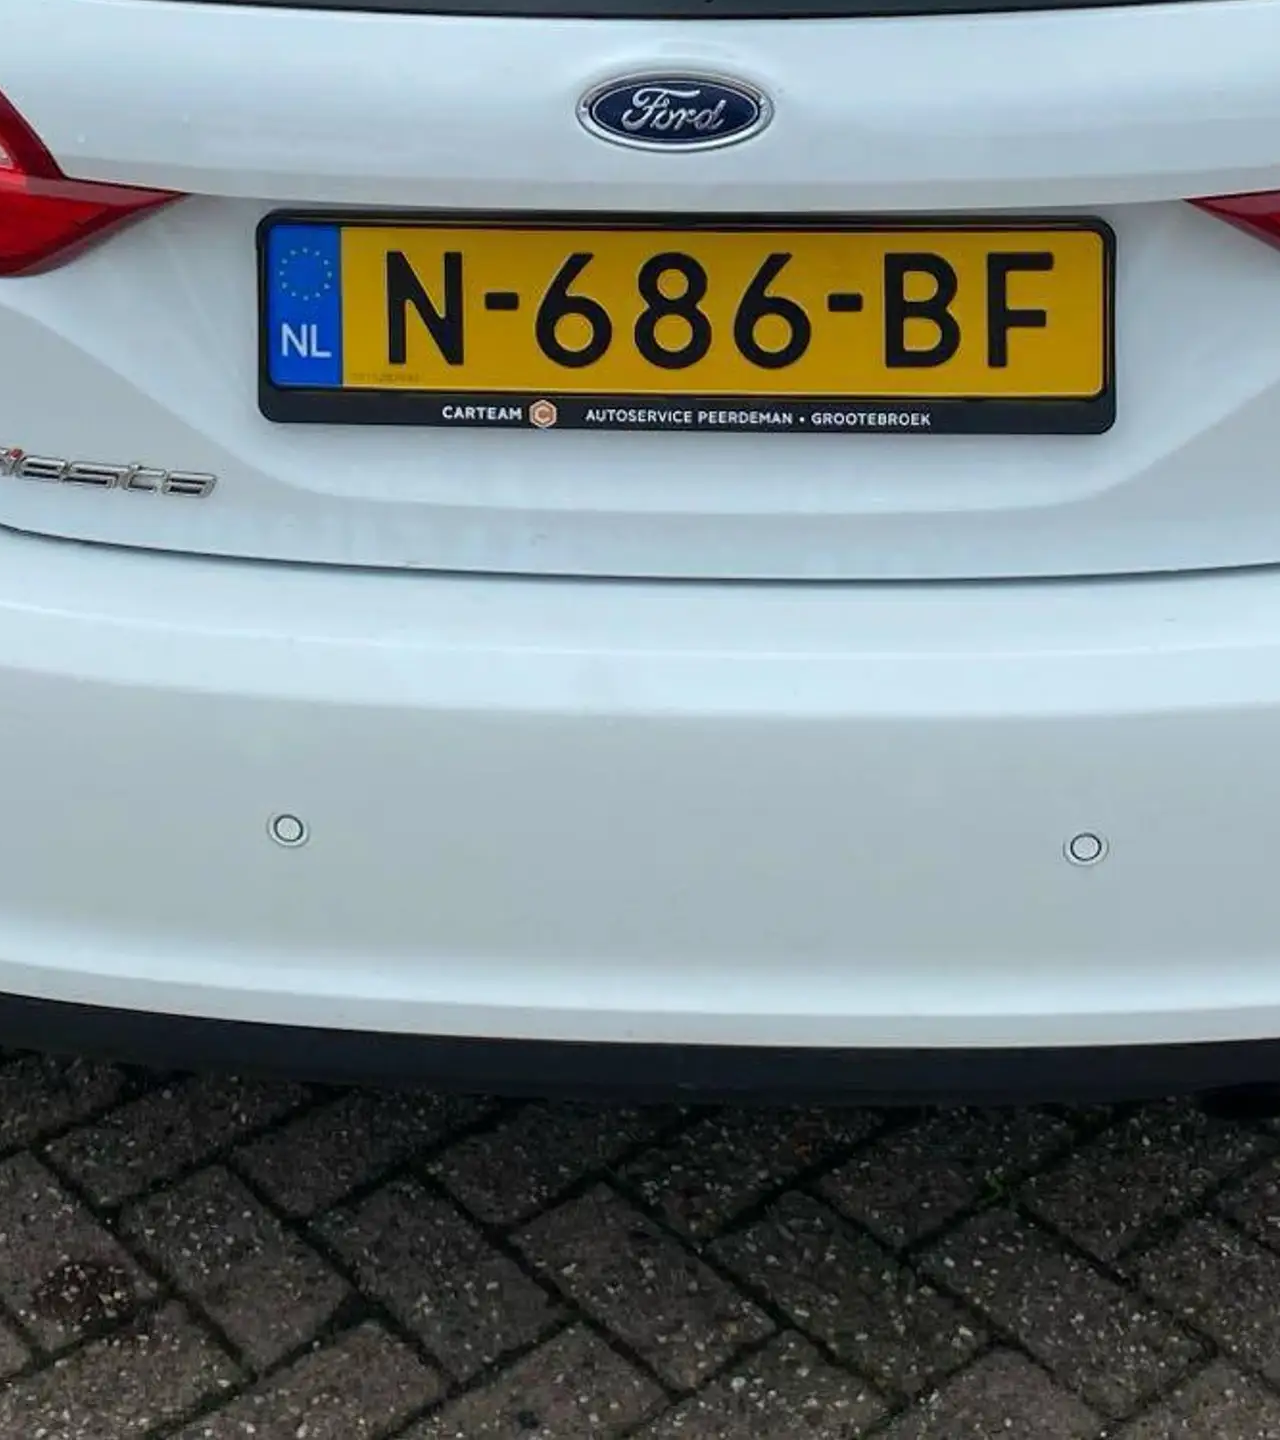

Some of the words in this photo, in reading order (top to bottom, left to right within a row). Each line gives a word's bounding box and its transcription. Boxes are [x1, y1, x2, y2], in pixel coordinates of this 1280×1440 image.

[621, 87, 727, 131] Ford
[386, 251, 1055, 370] N-686-BF
[281, 323, 331, 357] NL
[442, 406, 522, 420] CARTEAM
[585, 409, 692, 423] AUTOSERVICE
[698, 411, 793, 424] PEERDEMAN
[811, 412, 931, 426] GROOTEBROEK
